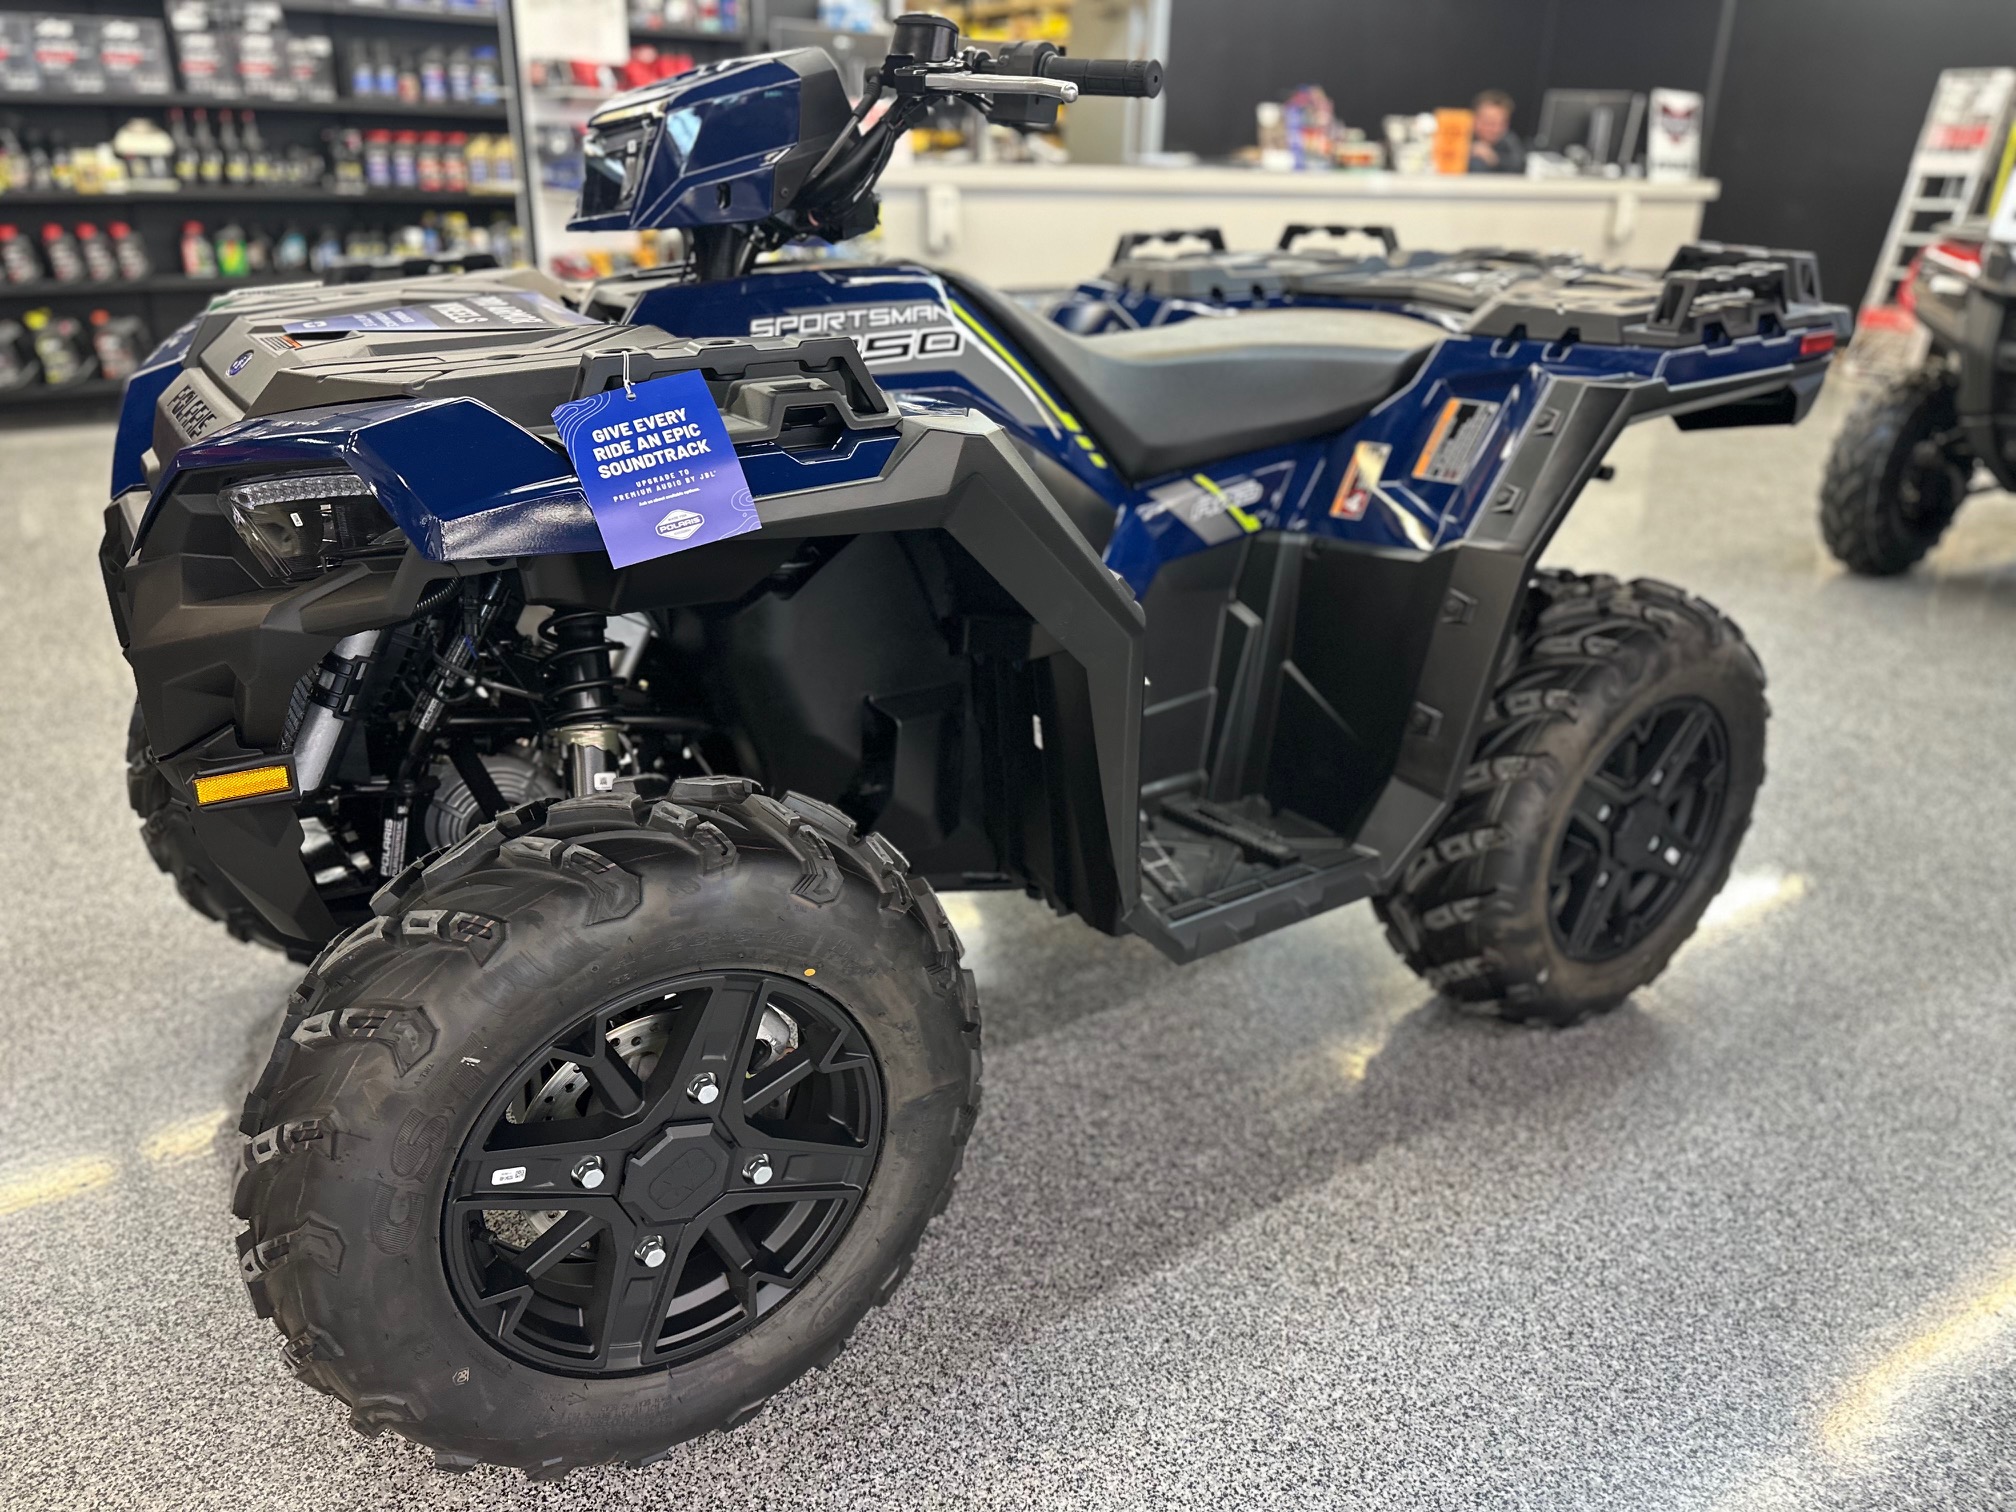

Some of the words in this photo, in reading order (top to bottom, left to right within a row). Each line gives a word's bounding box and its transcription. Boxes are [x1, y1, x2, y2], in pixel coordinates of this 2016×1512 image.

[750, 304, 949, 337] SPORTSMAN
[853, 326, 965, 366] 50
[167, 384, 217, 440] POLARIS
[591, 422, 633, 444] GIVE
[633, 407, 687, 431] EVERY
[592, 440, 635, 462] RIDE
[637, 434, 662, 452] AN
[661, 423, 702, 445] EPIC
[598, 439, 711, 479] SOUNDTRACK
[613, 487, 653, 503] PREMIUM
[656, 479, 682, 492] AUDIO
[686, 475, 695, 484] BY
[636, 472, 676, 488] UPGRADE
[679, 468, 690, 477] TO
[659, 516, 701, 533] POLARIS
[380, 818, 394, 876] POLARIS
[370, 1031, 487, 1255] CST
